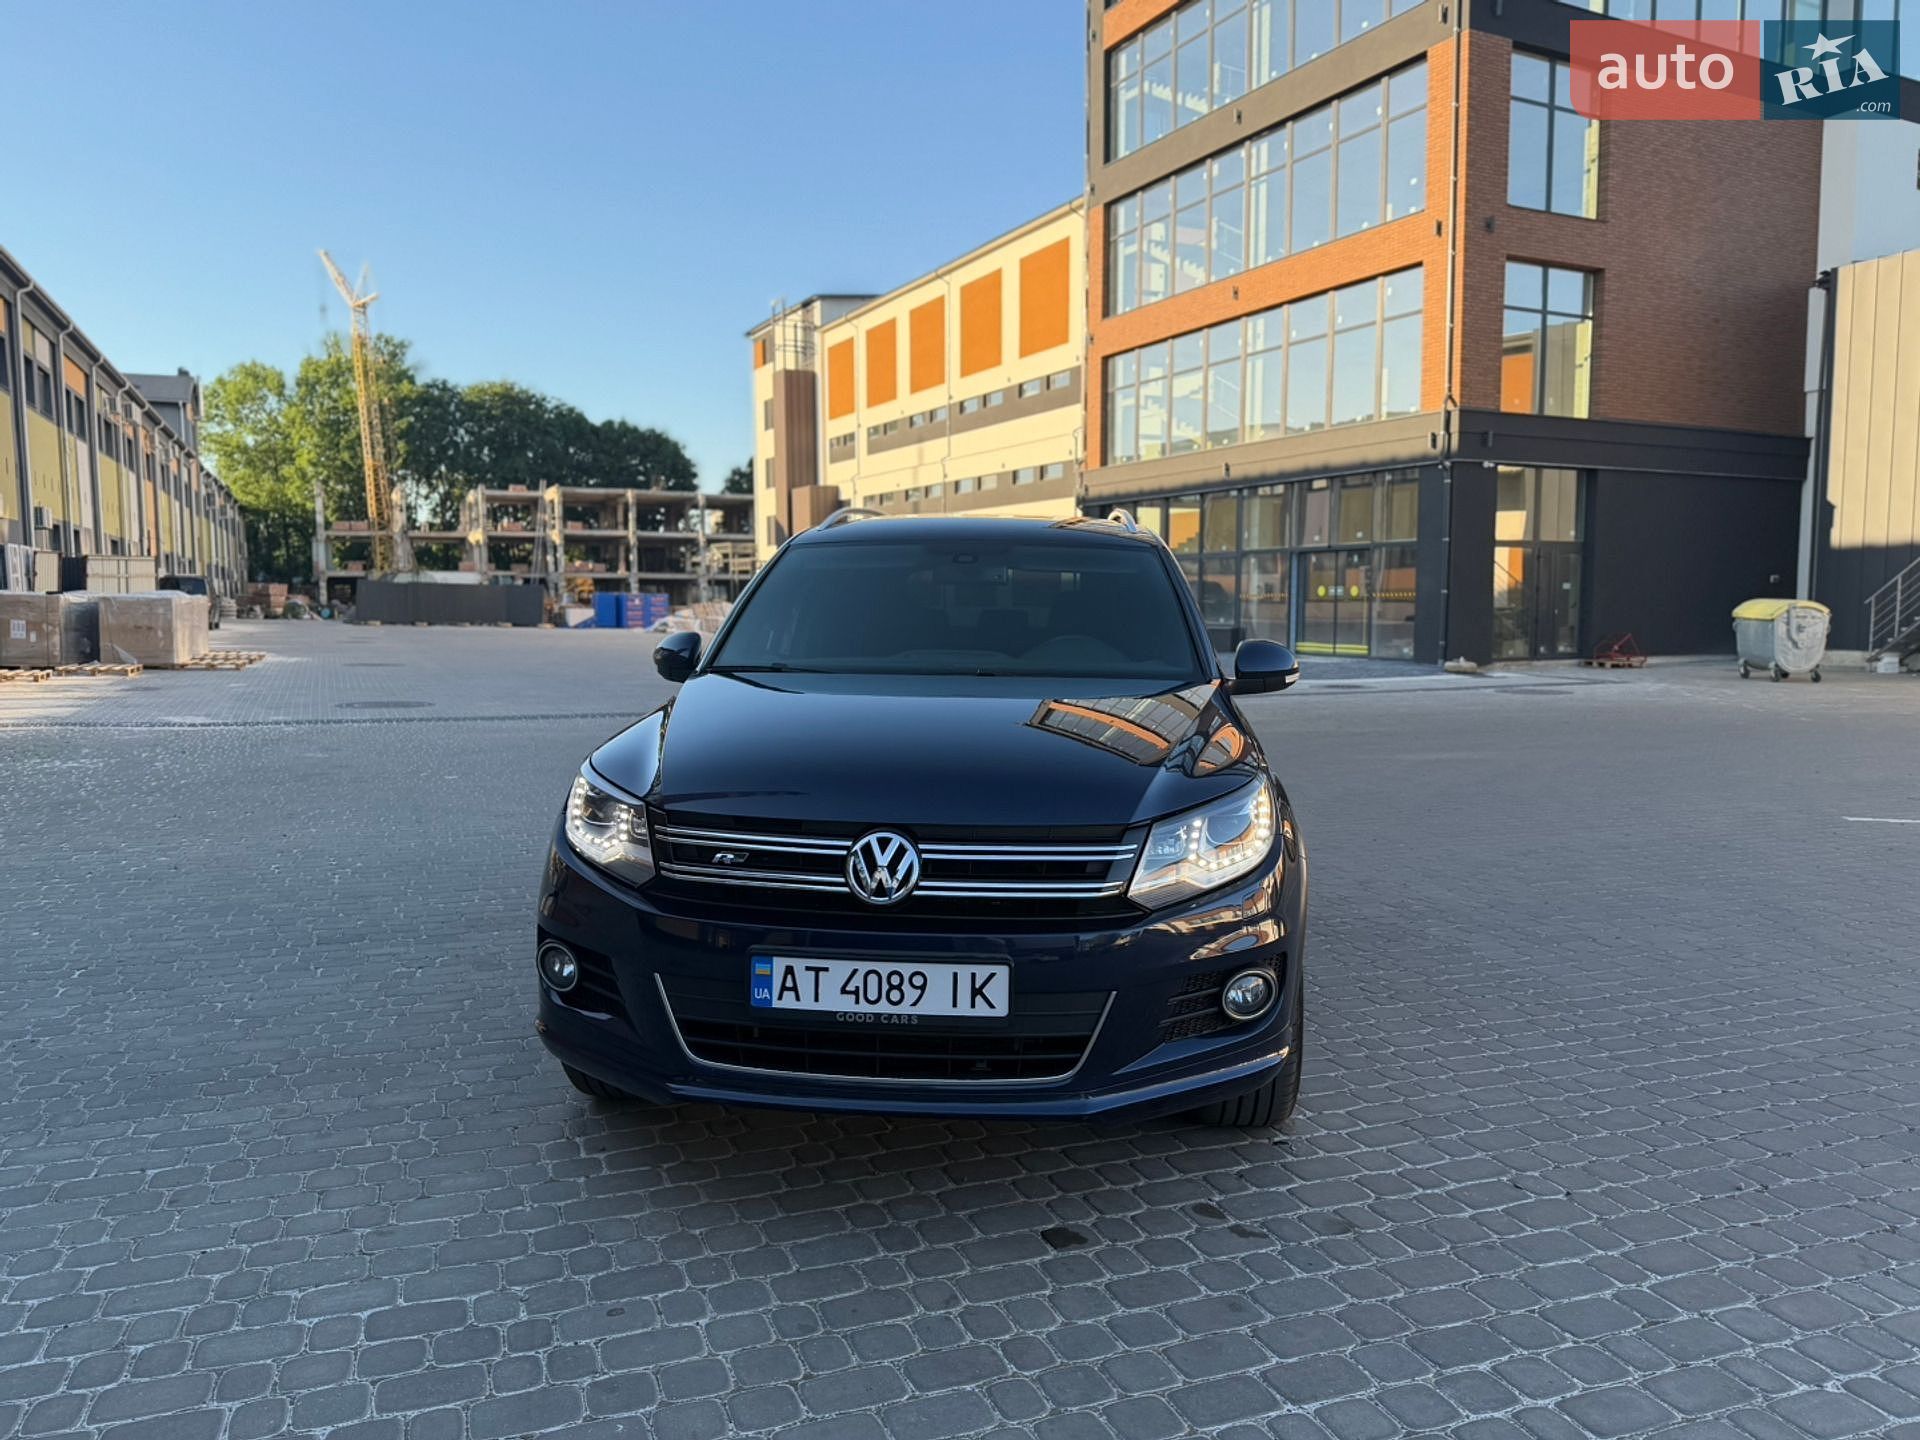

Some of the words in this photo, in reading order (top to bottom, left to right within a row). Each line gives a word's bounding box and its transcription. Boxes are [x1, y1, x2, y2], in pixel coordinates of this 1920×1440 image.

[754, 987, 771, 1000] UA
[776, 965, 830, 1003] AT
[840, 968, 928, 1007] 4089
[951, 971, 998, 1009] IK
[836, 1012, 875, 1024] GOOD
[880, 1013, 919, 1025] CARS
